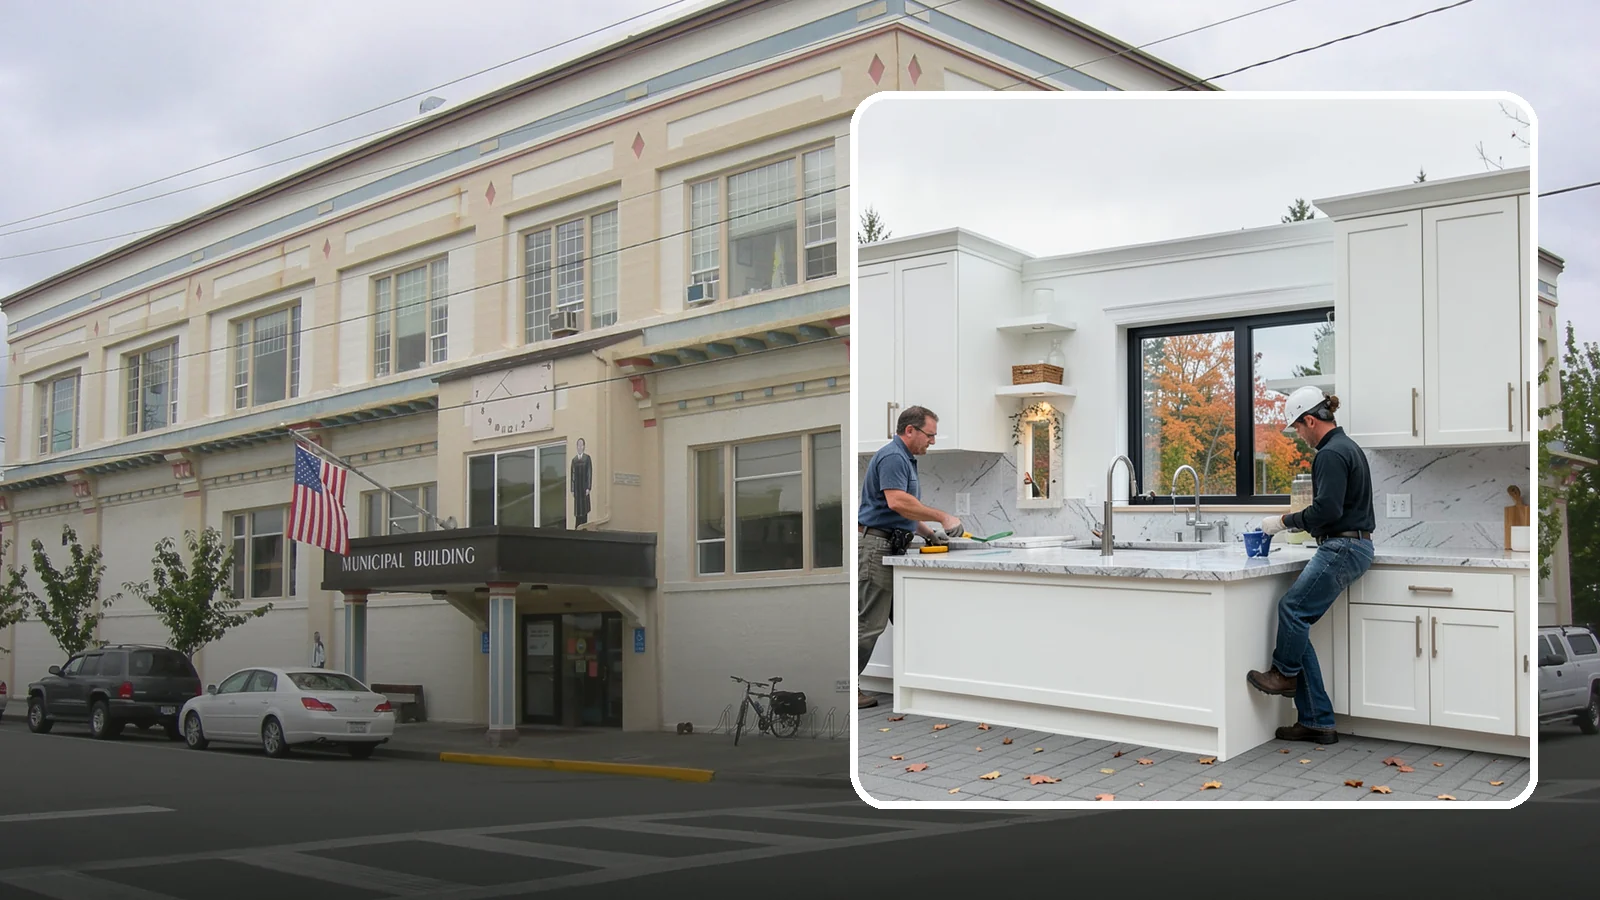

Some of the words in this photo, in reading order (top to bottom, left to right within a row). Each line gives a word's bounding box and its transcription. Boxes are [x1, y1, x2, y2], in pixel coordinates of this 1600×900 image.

[546, 362, 552, 370] 6
[529, 414, 533, 422] 3
[342, 552, 405, 572] MUNICIPAL
[414, 546, 475, 566] BUILDING
